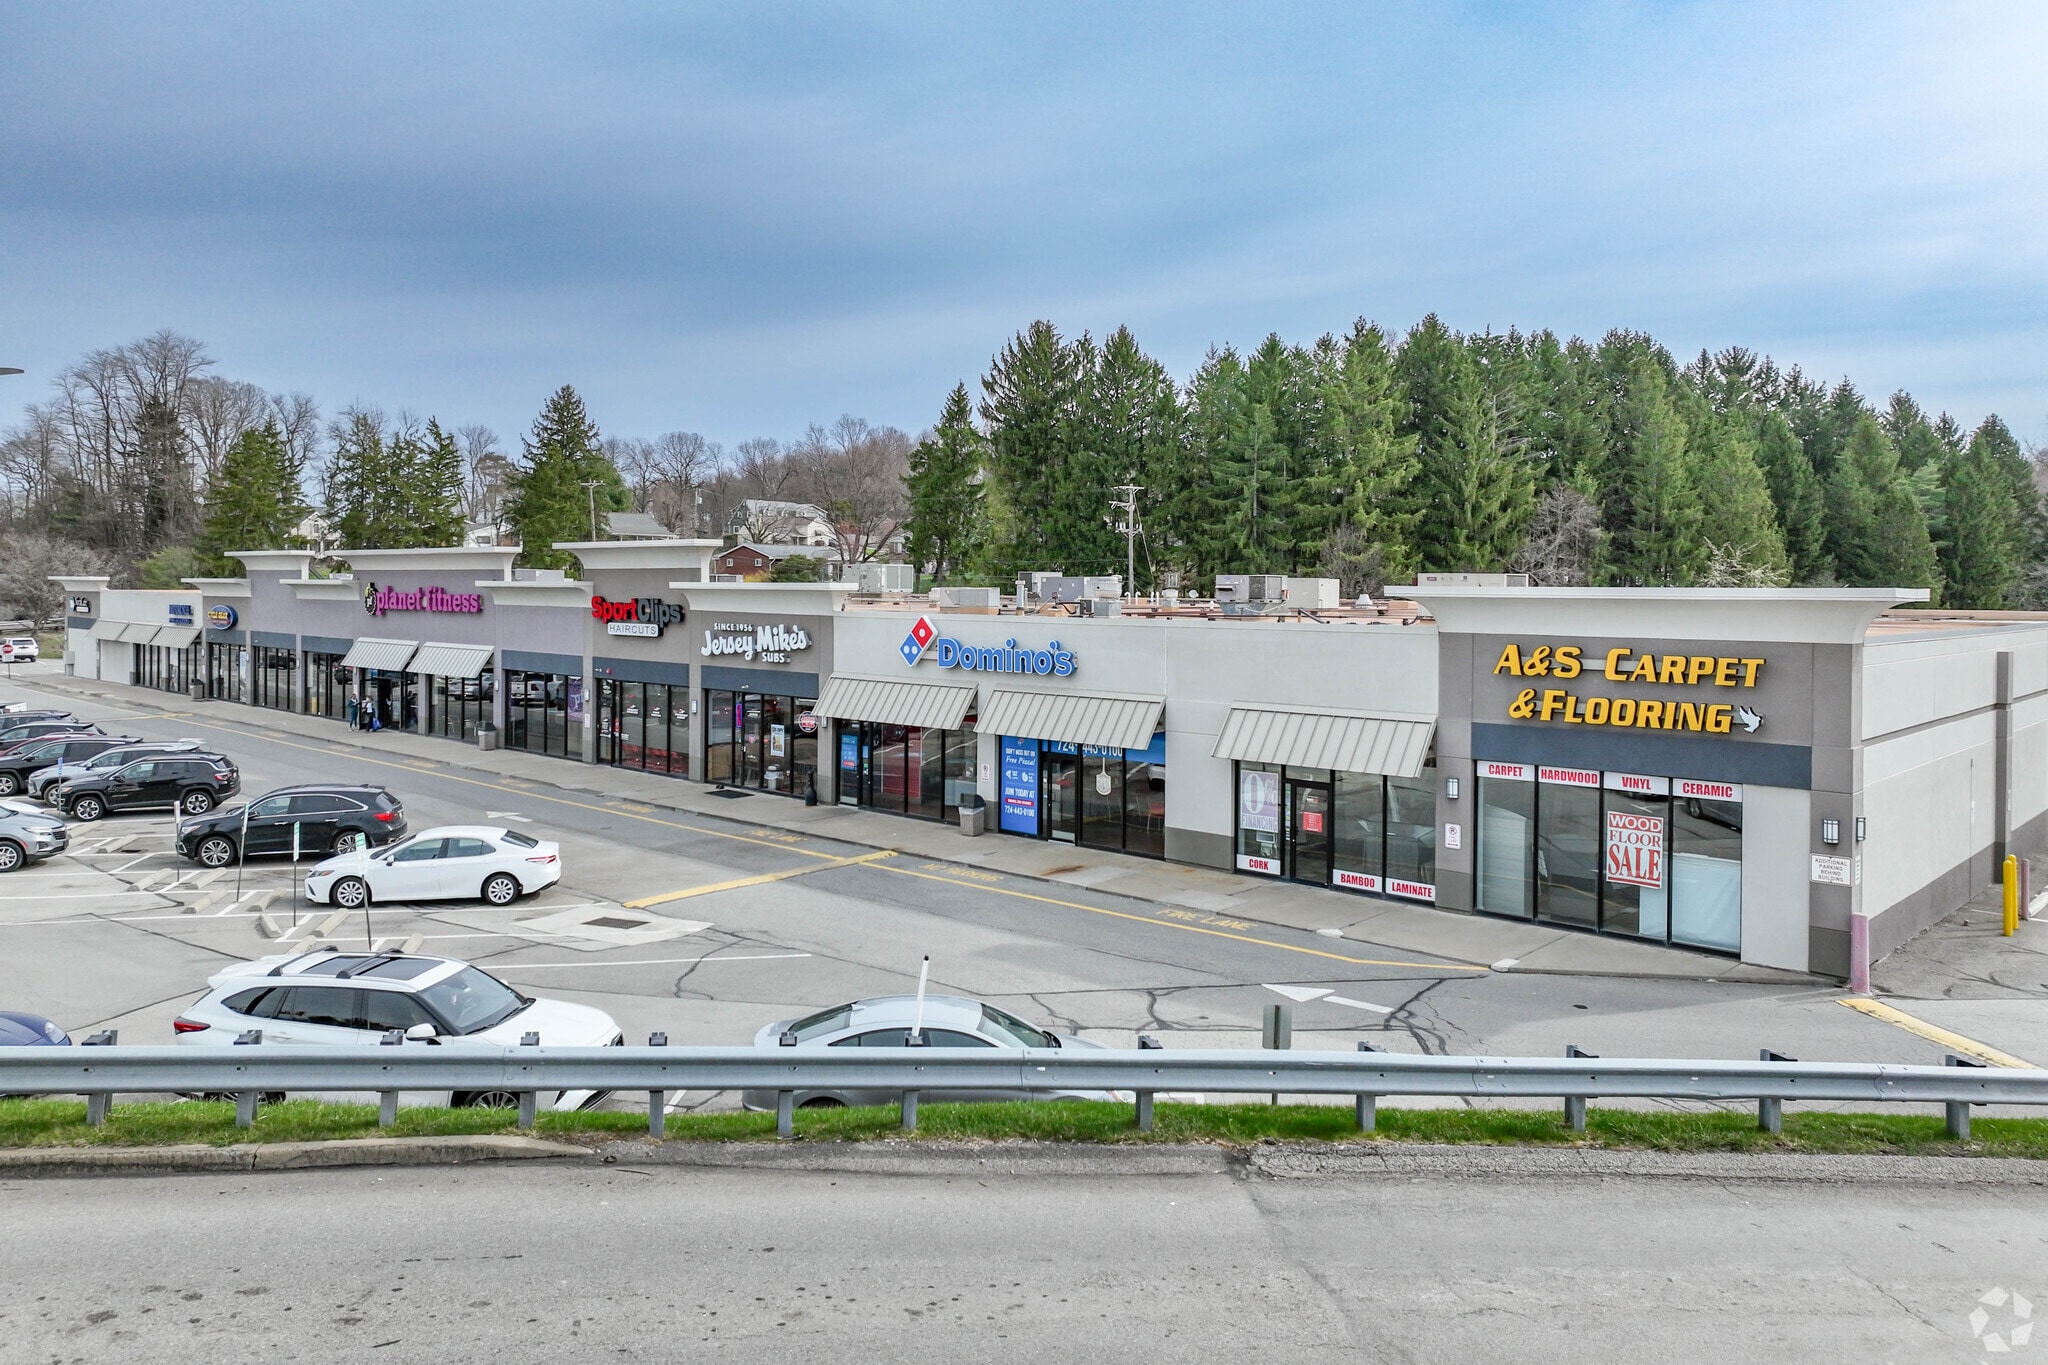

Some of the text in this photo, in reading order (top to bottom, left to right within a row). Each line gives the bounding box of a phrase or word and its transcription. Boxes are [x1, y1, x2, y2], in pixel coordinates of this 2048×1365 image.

[375, 585, 481, 616] planet fitness
[609, 624, 657, 635] HAIRCUTS
[714, 622, 753, 632] SINCE 1956
[700, 623, 808, 661] Jersey Mike's
[762, 651, 785, 663] SUBS
[937, 636, 1076, 677] Domino's
[1492, 643, 1767, 688] A&S CARPET
[1488, 764, 1524, 778] CARPET
[1541, 769, 1598, 785] HARDWOOD
[1621, 776, 1652, 791] VINYL
[1682, 782, 1733, 798] CERAMIC
[1015, 788, 1029, 798] TODAY
[1029, 790, 1036, 798] AT
[1243, 773, 1278, 815] 0%
[1241, 815, 1278, 832] FINANCING
[1609, 814, 1662, 832] WOOD
[1609, 830, 1661, 848] FLOOR
[1248, 858, 1269, 871] CORK
[1608, 843, 1661, 882] SALE
[1814, 858, 1848, 867] ADDITIONAL
[1819, 864, 1843, 872] PARKING
[1340, 873, 1375, 889] BAMBOO
[1817, 874, 1844, 882] BUILDING
[1820, 869, 1842, 877] BEHIND
[1391, 881, 1432, 898] LAMINATE
[1200, 916, 1259, 931] LANE
